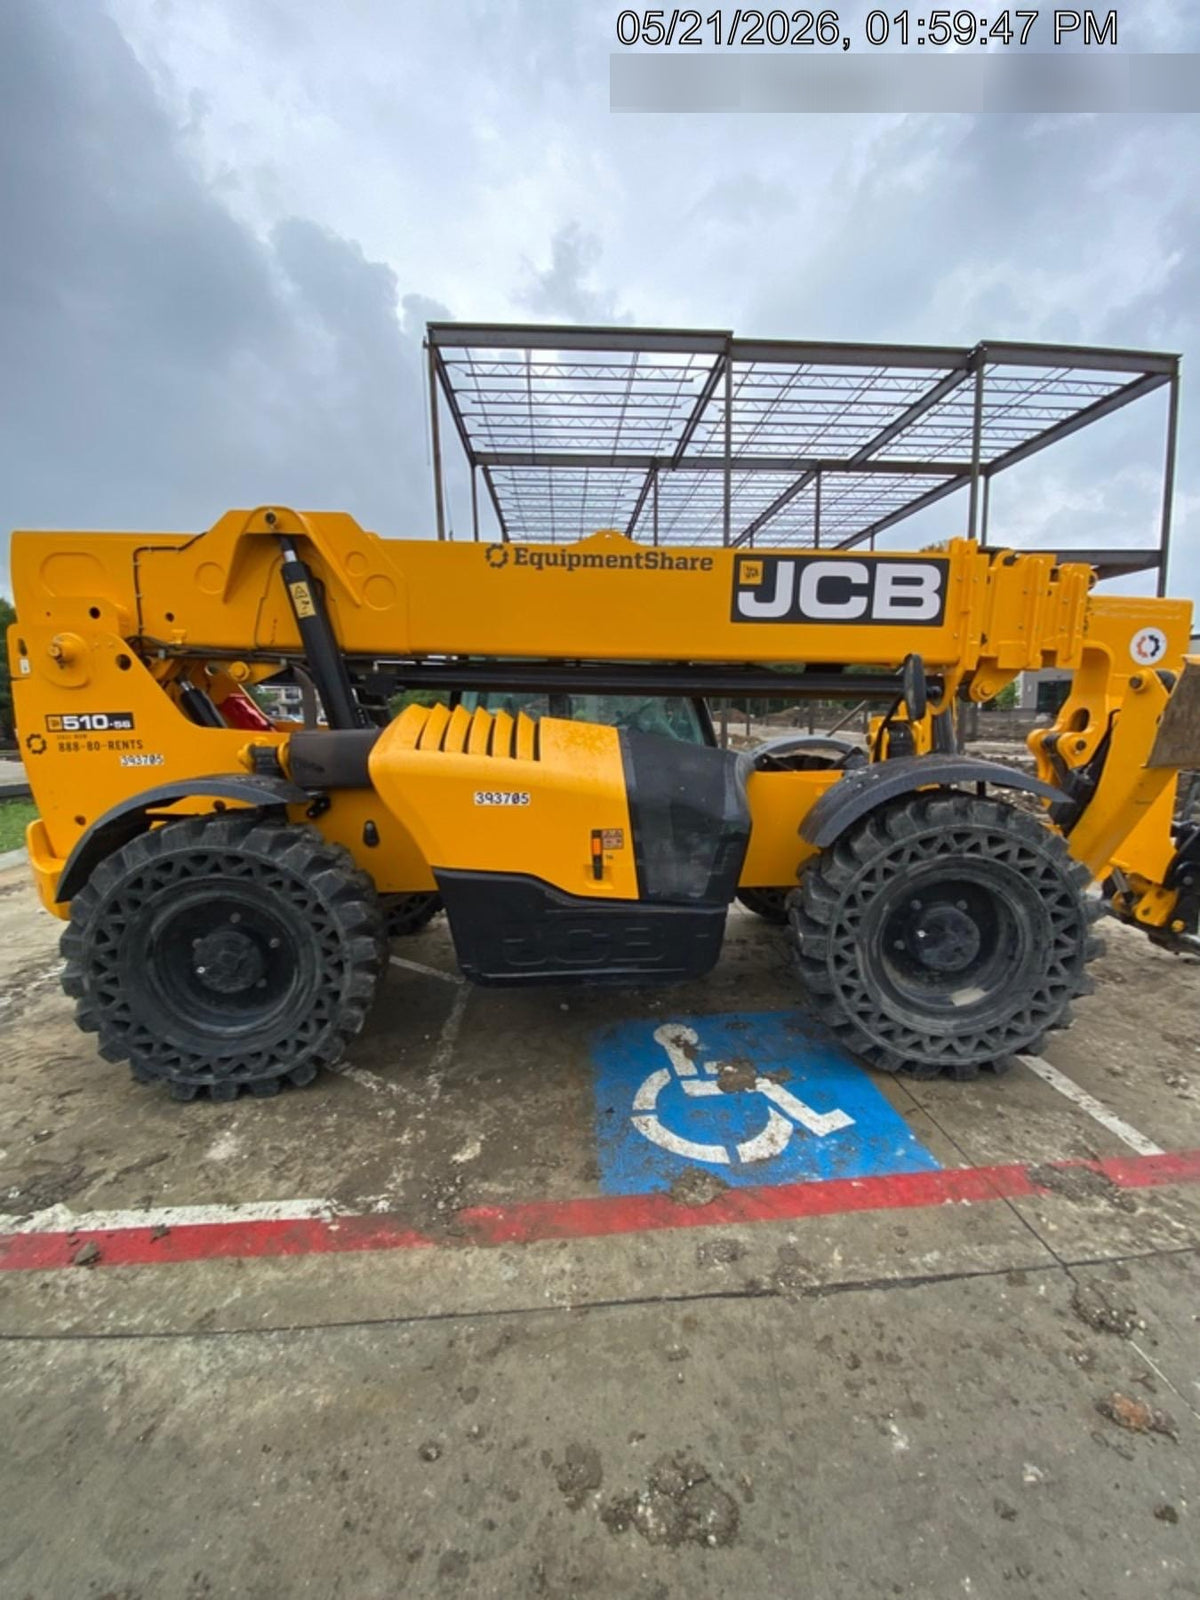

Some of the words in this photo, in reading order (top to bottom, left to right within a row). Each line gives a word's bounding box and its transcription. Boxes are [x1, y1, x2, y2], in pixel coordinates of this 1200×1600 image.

[513, 549, 713, 573] EquipmentShare
[738, 560, 942, 621] JCB
[476, 792, 529, 804] 393705
